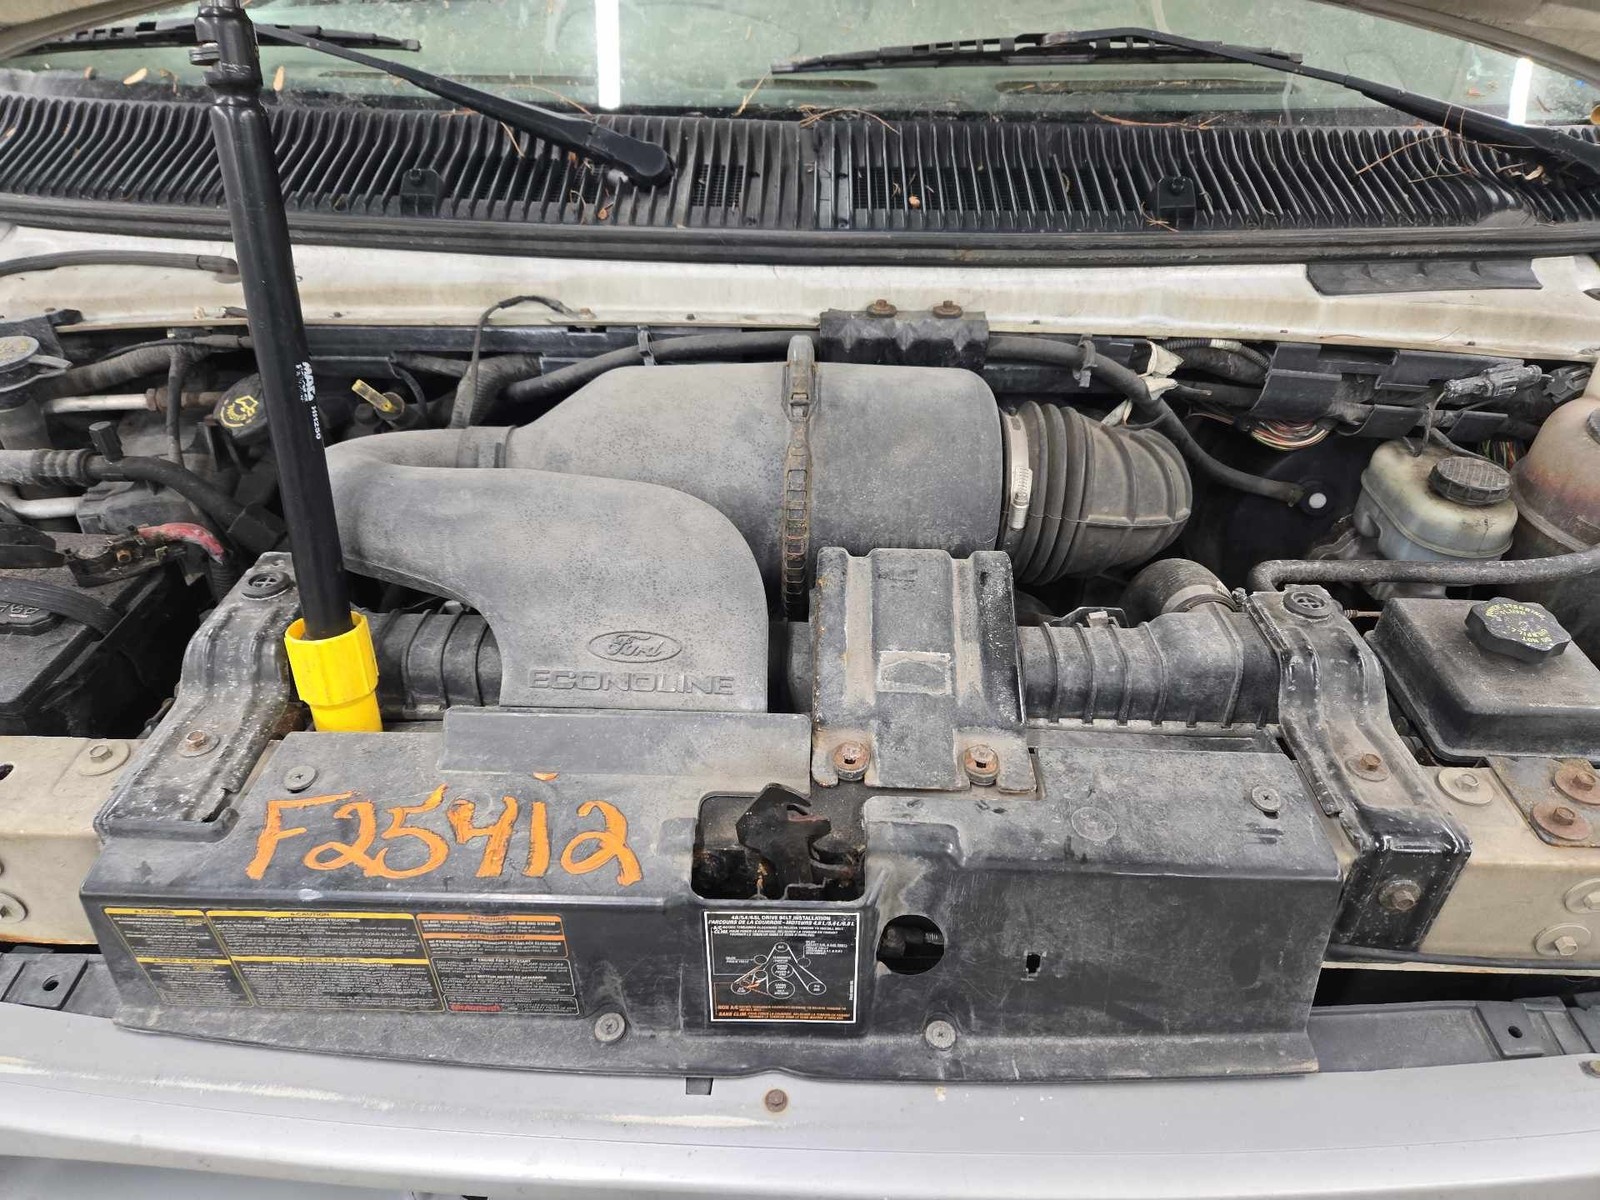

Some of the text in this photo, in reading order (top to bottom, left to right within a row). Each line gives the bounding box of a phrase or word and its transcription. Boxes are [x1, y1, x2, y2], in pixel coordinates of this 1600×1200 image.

[606, 633, 665, 657] Ford
[529, 668, 735, 696] ECONOLINE
[245, 783, 644, 888] F25412
